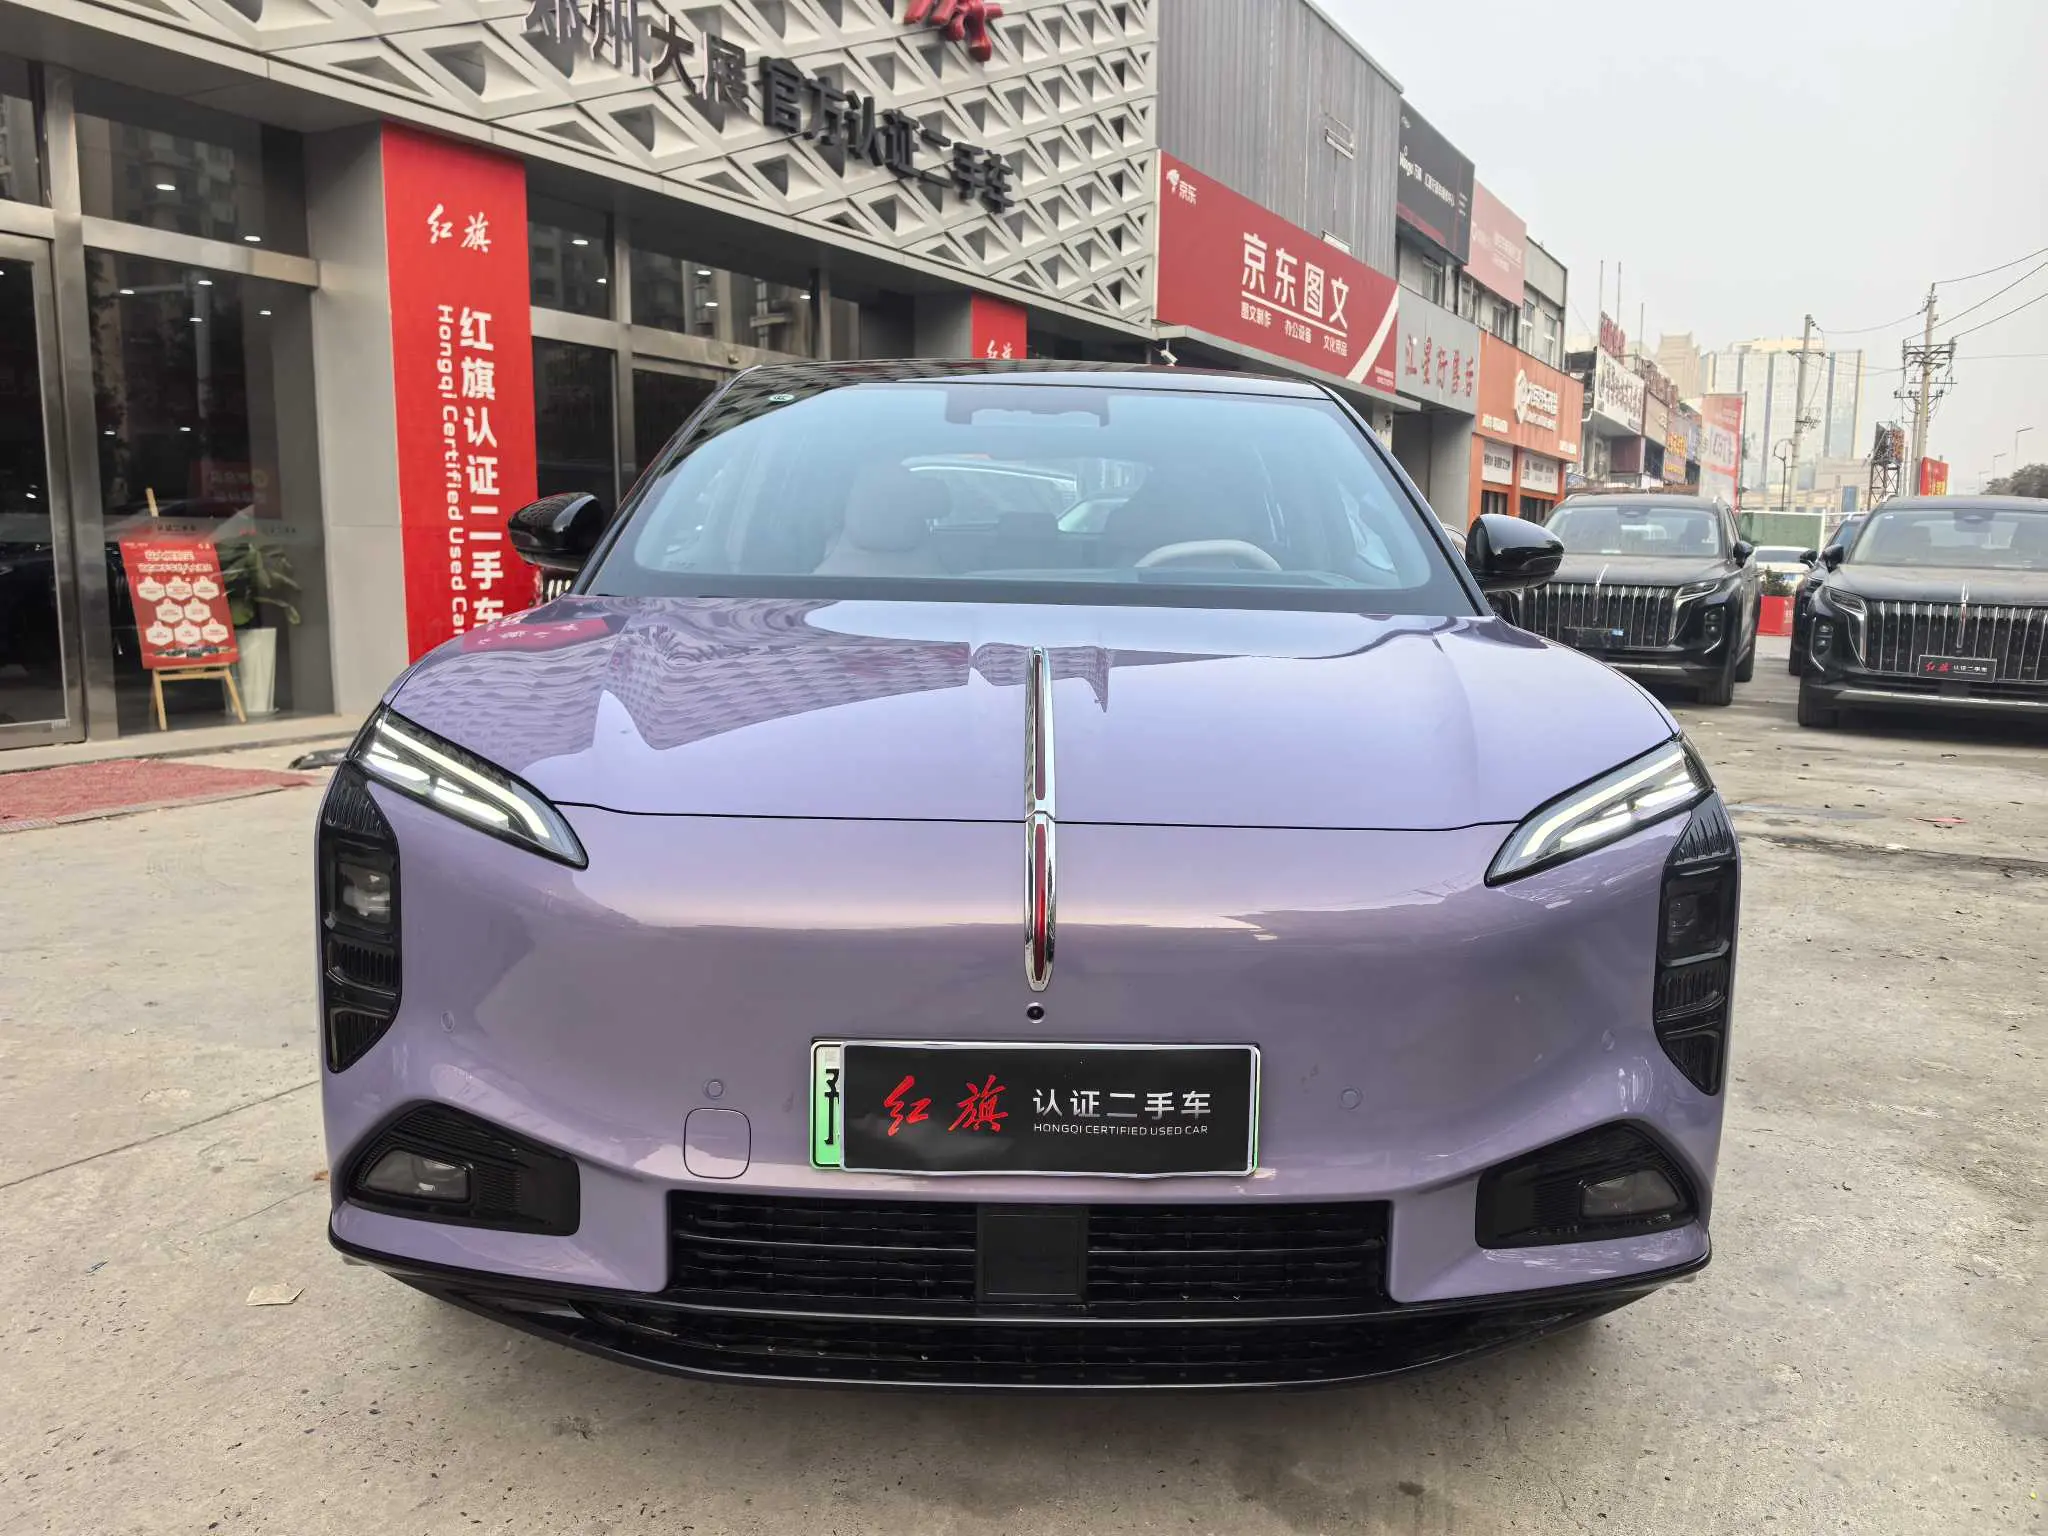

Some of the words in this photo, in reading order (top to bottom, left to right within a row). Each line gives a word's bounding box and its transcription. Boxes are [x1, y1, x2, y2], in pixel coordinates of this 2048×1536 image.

[1179, 180, 1197, 205] 京东
[427, 203, 492, 252] 红旗
[1241, 232, 1350, 329] 京东图文
[437, 304, 458, 399] Hongqi
[442, 405, 464, 521] Certified
[459, 306, 504, 628] 红旗认证二手车
[448, 526, 467, 592] Used
[882, 1074, 1009, 1137] 红旗
[1032, 1088, 1211, 1120] 认证二手车
[1033, 1122, 1083, 1134] HONGQI
[1085, 1124, 1147, 1136] CERTIFIED
[1150, 1125, 1182, 1136] USED
[1184, 1125, 1208, 1135] CAR
